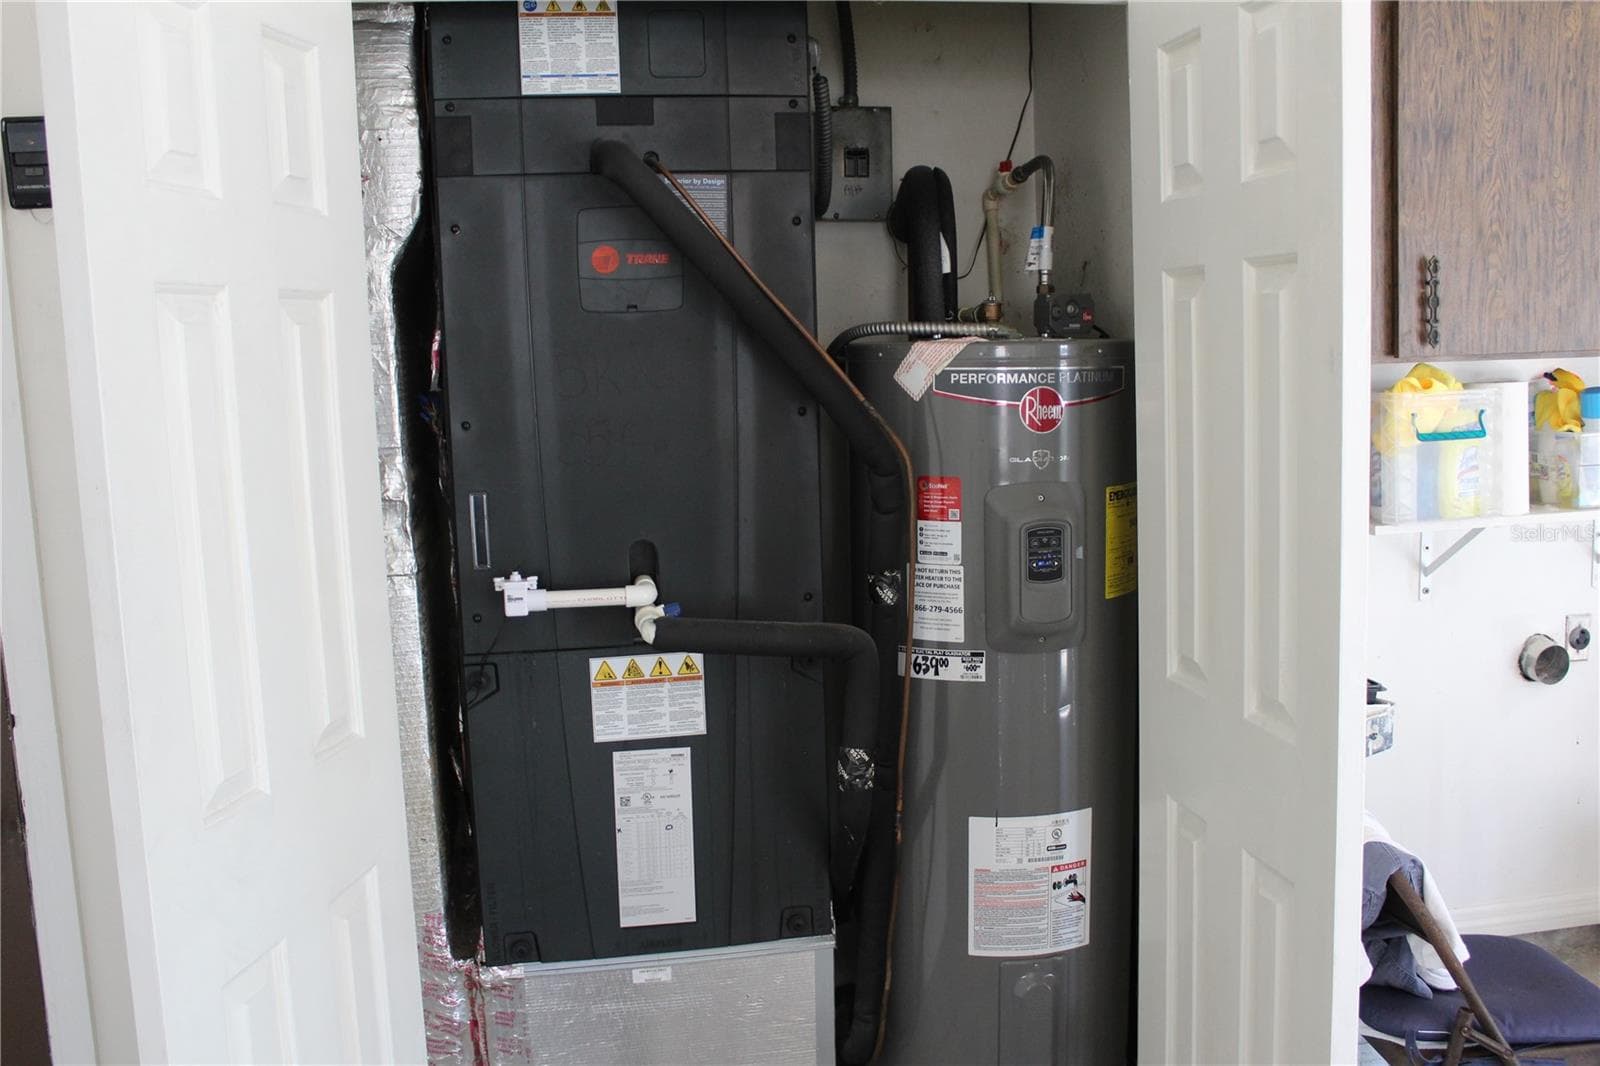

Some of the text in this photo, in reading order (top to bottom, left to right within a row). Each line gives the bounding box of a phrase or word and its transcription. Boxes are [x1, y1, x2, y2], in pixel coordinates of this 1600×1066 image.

[702, 177, 725, 187] Design
[626, 253, 671, 265] TRANE
[950, 371, 1115, 385] PERFORMANCE PLATINUM
[1025, 388, 1063, 426] Rheem
[1059, 861, 1085, 871] DANGER
